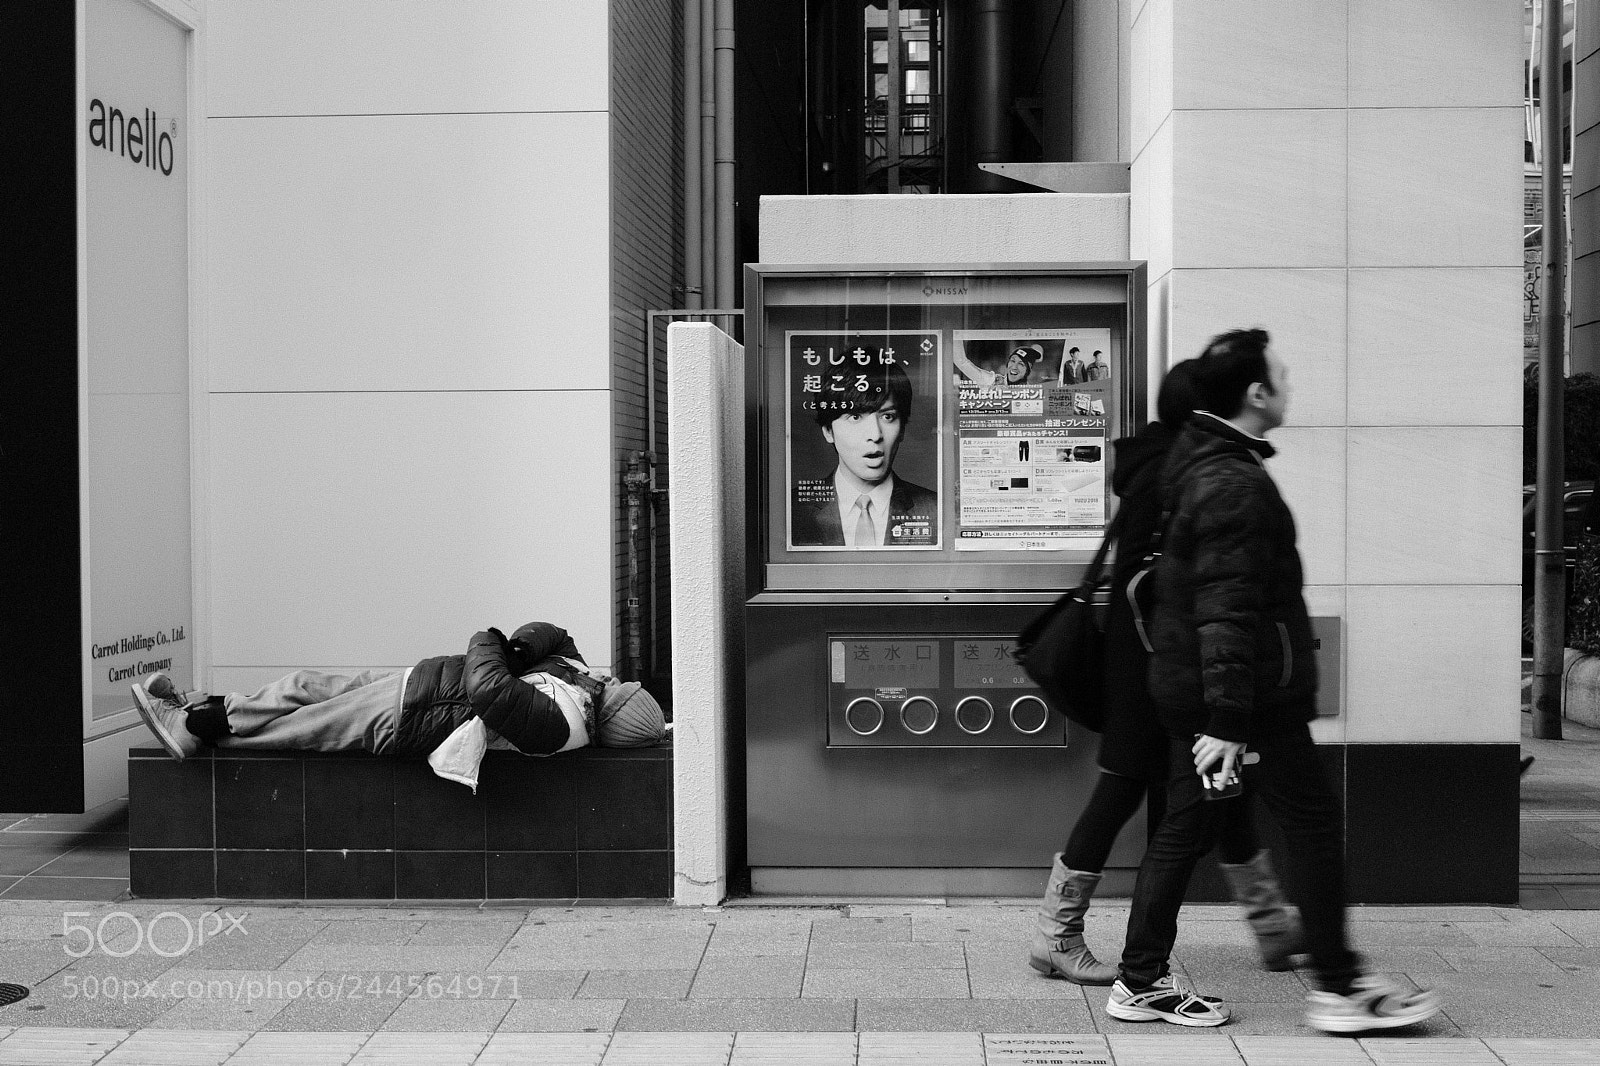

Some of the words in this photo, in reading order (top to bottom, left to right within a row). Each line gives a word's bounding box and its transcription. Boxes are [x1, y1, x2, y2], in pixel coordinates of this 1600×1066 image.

[89, 98, 173, 176] anello
[936, 287, 968, 295] NISSAY
[803, 347, 909, 366] もしもは、
[803, 374, 882, 393] 起こる。
[959, 400, 1010, 409] キャンペーン
[1045, 419, 1105, 427] 抽選でプレゼント!
[92, 641, 119, 659] Carrot
[120, 634, 156, 652] Holdings
[171, 625, 186, 642] Ltd.
[853, 643, 931, 661] 送水口
[108, 664, 135, 683] Carrot
[137, 657, 172, 675] Company
